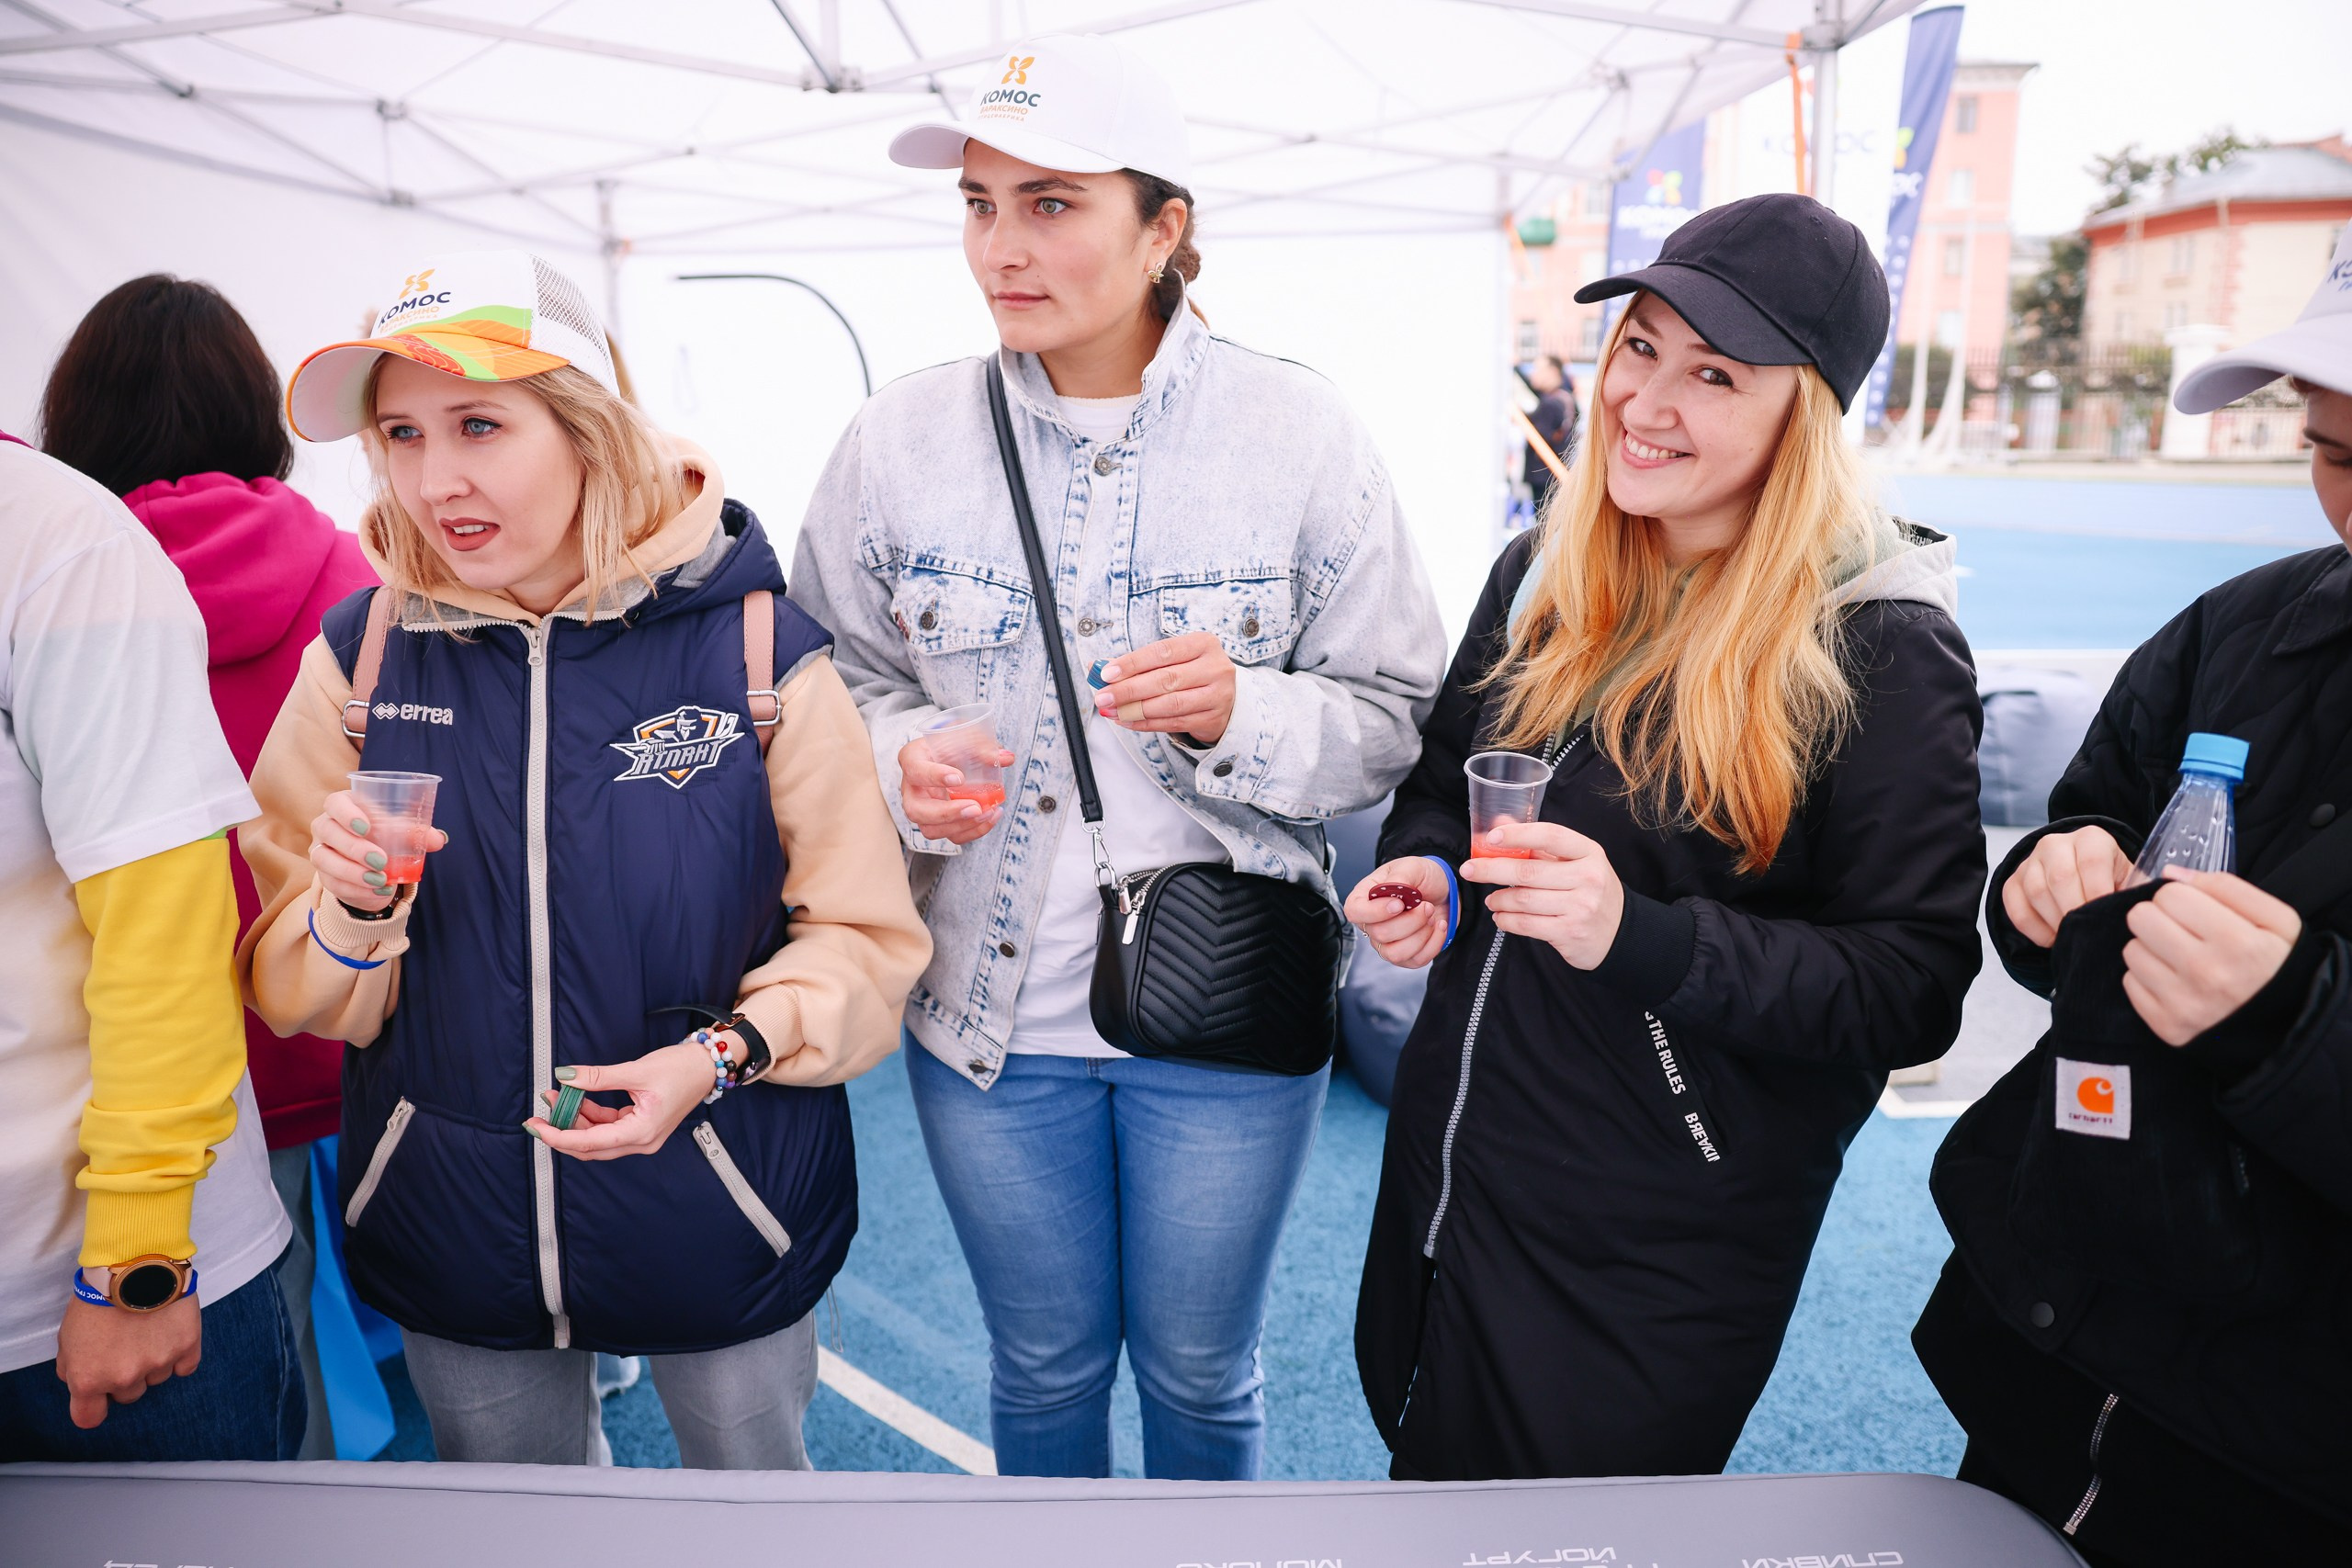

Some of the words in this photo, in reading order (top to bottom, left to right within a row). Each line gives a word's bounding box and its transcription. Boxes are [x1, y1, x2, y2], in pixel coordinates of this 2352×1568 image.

[980, 89, 1041, 107] КОМОС
[378, 291, 451, 329] КОМОС
[1648, 1020, 1669, 1050] THE
[1658, 1048, 1687, 1095] RULES
[1463, 1547, 1617, 1565] ЙОГУРТ
[1742, 1551, 1905, 1568] СЛИВКИ
